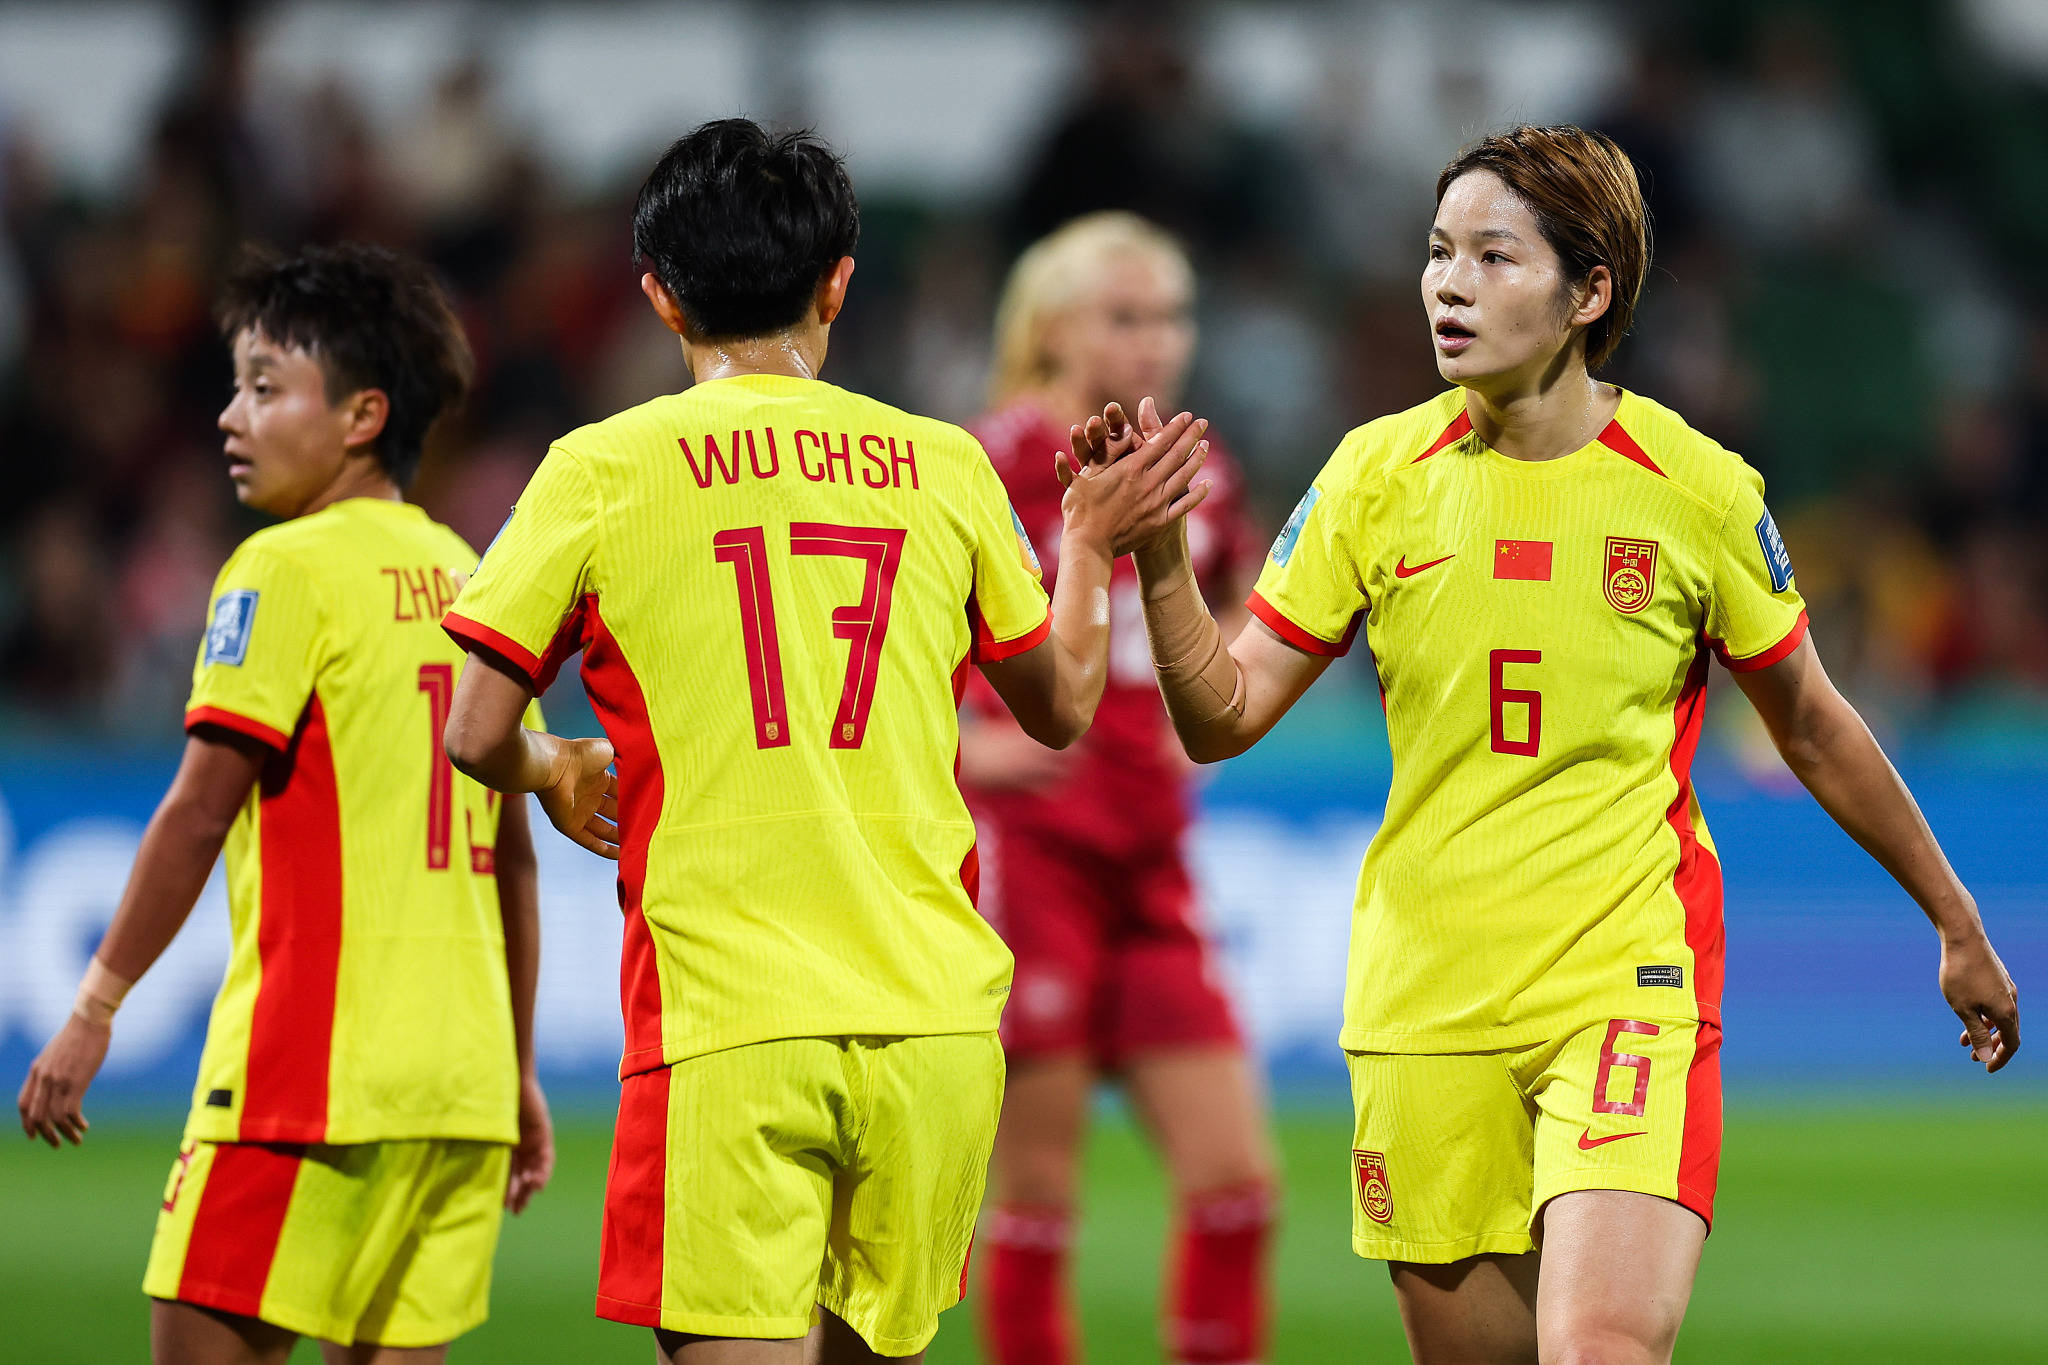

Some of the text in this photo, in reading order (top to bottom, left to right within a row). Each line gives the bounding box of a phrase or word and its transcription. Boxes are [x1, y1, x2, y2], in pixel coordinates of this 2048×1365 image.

[678, 427, 780, 489] WU
[1611, 543, 1651, 560] CFA
[381, 567, 466, 622] ZHA
[713, 521, 908, 750] 17
[1489, 648, 1542, 758] 6
[418, 663, 498, 875] 1
[1592, 1018, 1661, 1117] 6
[1358, 1156, 1383, 1171] CFA
